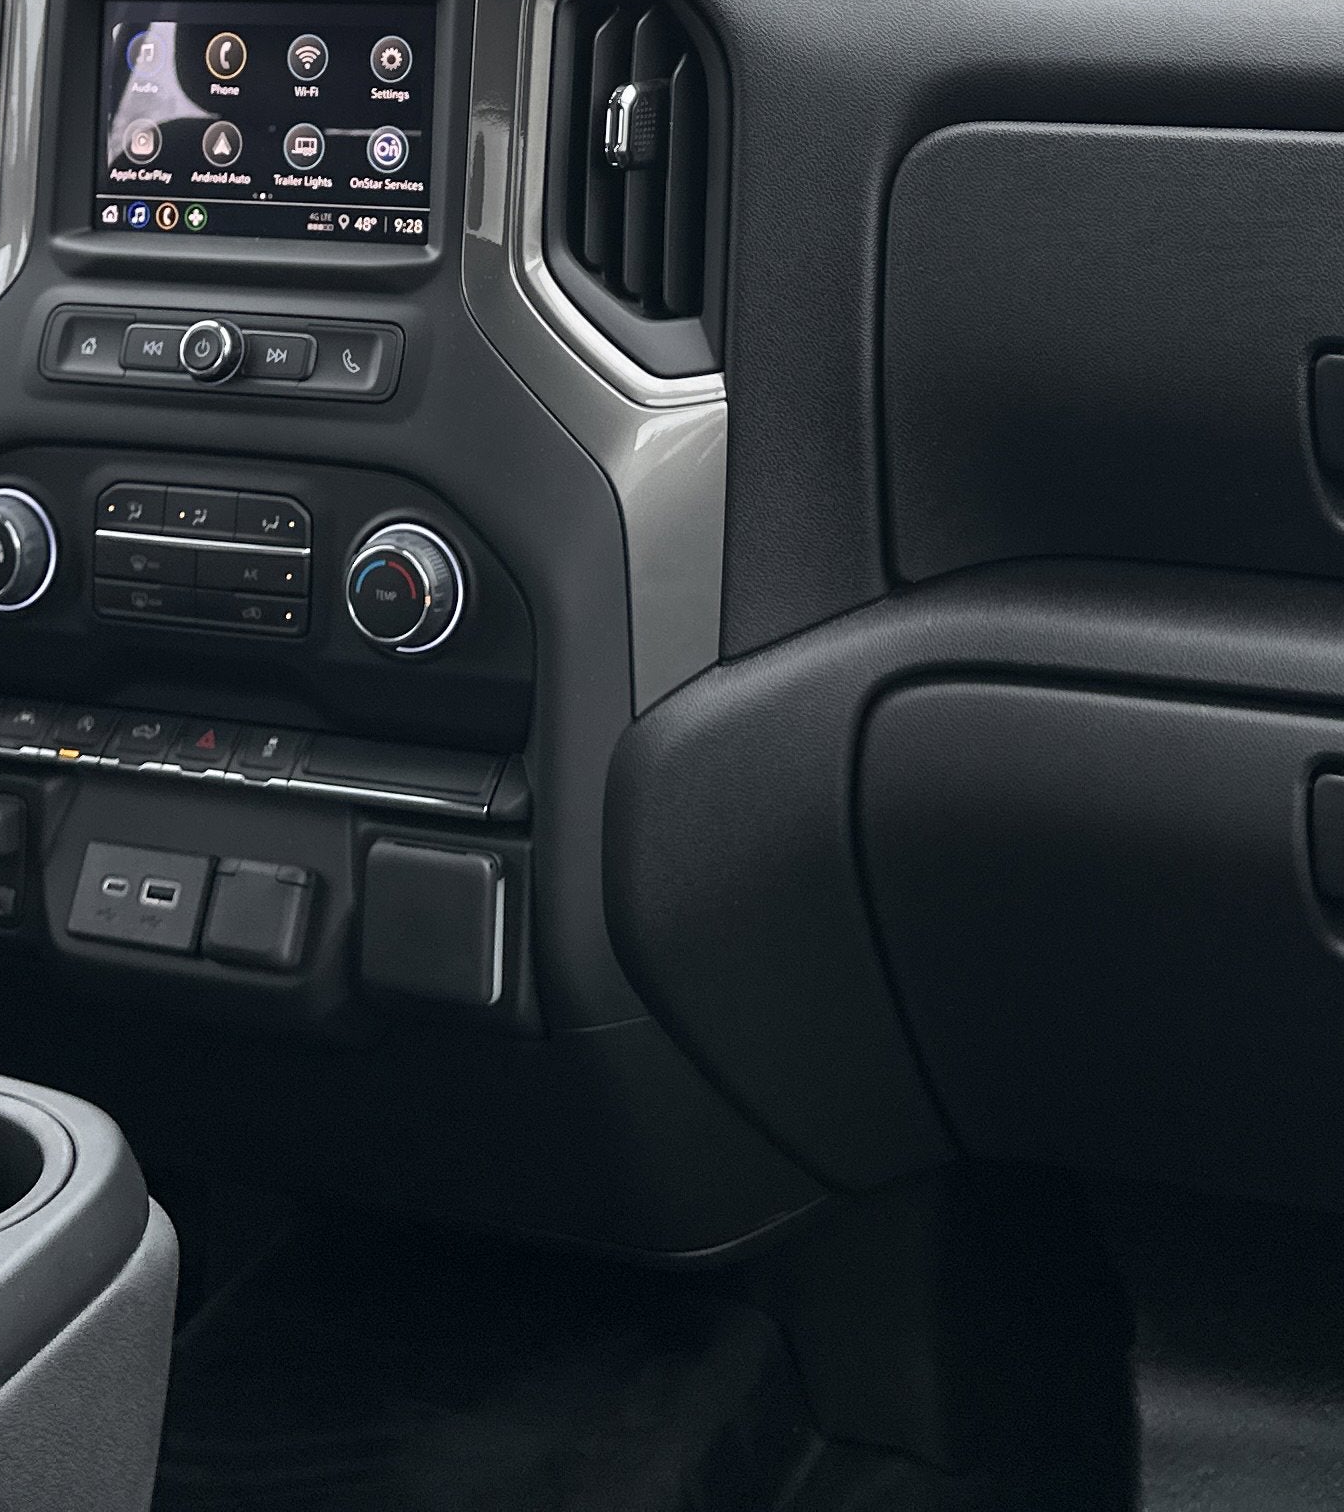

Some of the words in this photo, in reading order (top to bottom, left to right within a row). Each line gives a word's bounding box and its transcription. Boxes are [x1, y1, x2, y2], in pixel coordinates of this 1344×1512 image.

[210, 84, 240, 95] Phone
[294, 86, 319, 97] Wi-Fi
[371, 88, 409, 102] Settings
[110, 168, 136, 181] Apple
[137, 170, 172, 183] CarPlay
[191, 172, 227, 183] Android
[228, 173, 251, 184] Auto
[273, 174, 303, 186] Trailer
[304, 176, 333, 189] Lights
[350, 177, 383, 189] OnStar
[384, 178, 424, 191] Services
[394, 219, 423, 233] 9:28
[375, 589, 397, 601] TEMP
